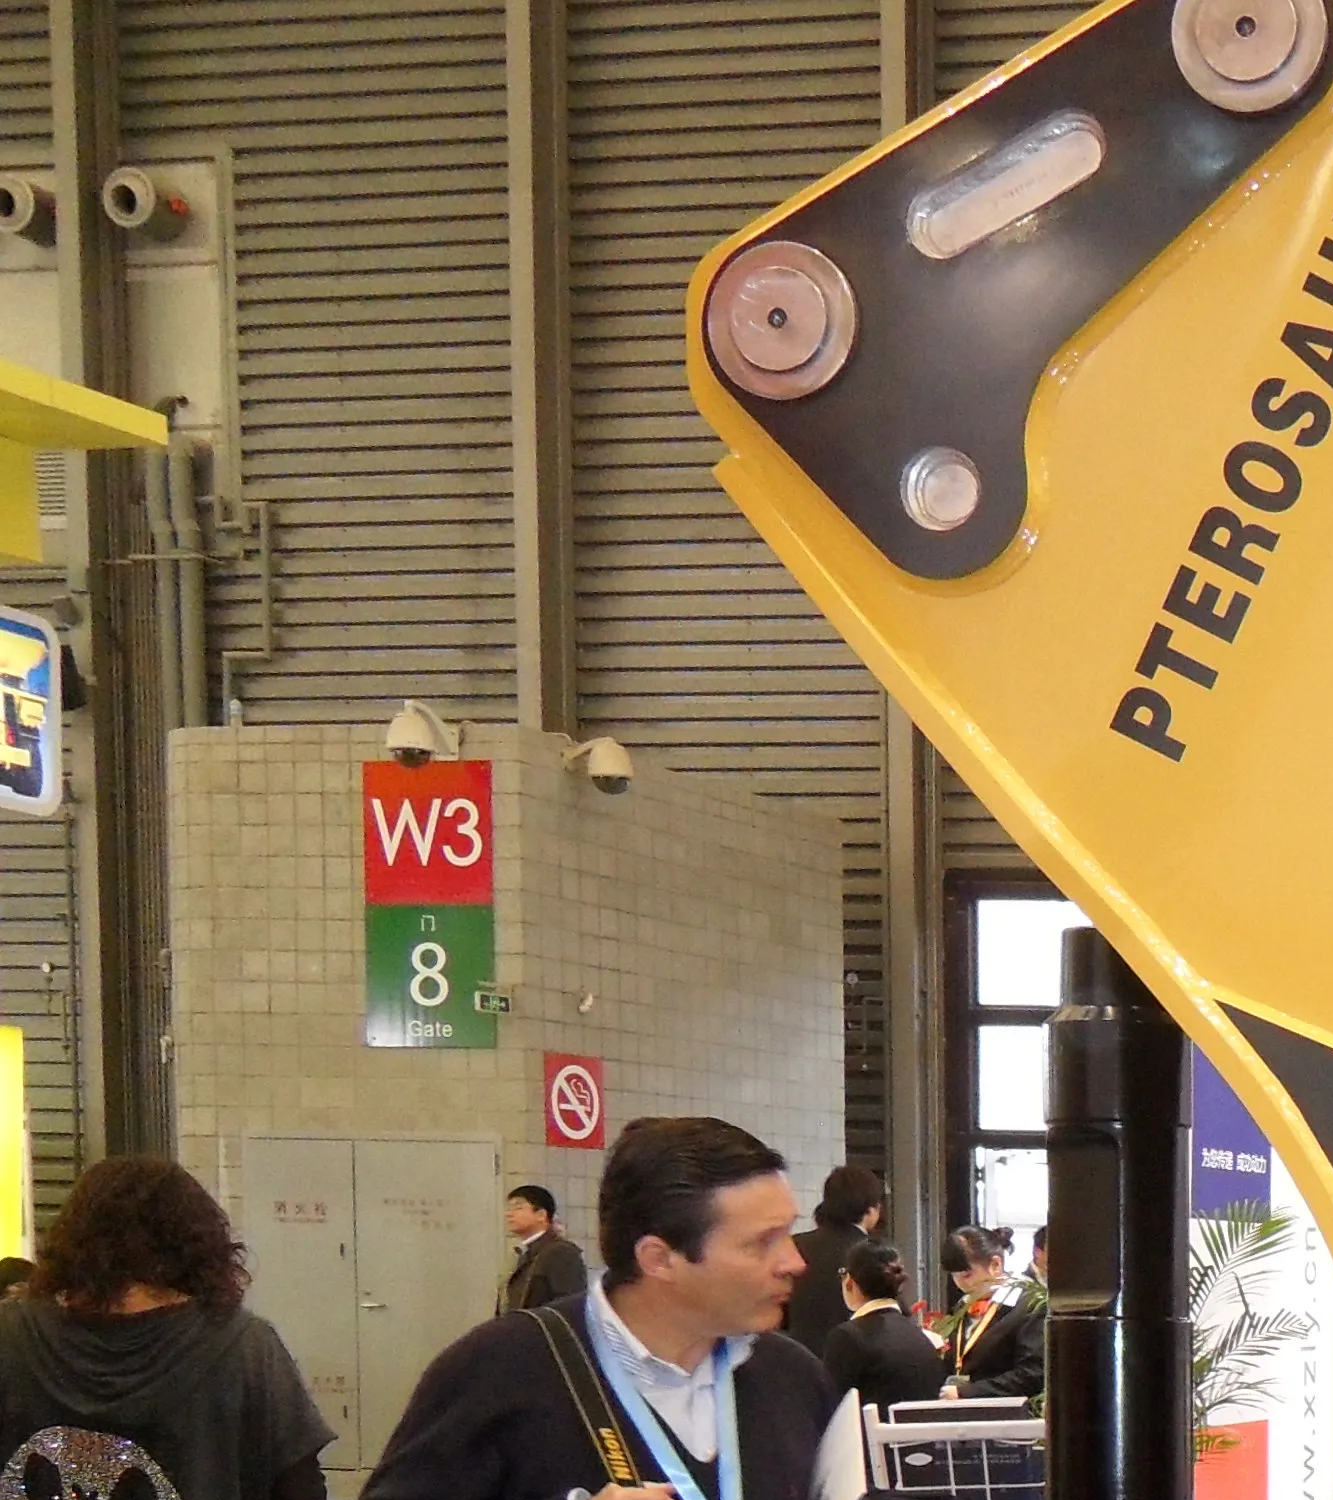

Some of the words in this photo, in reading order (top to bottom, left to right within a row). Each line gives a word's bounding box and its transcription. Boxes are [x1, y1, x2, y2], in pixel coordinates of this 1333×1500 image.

[371, 798, 483, 868] W3
[419, 914, 436, 932] 门
[409, 941, 450, 1007] 8
[408, 1020, 454, 1038] Gate
[597, 1426, 633, 1481] Nikon
